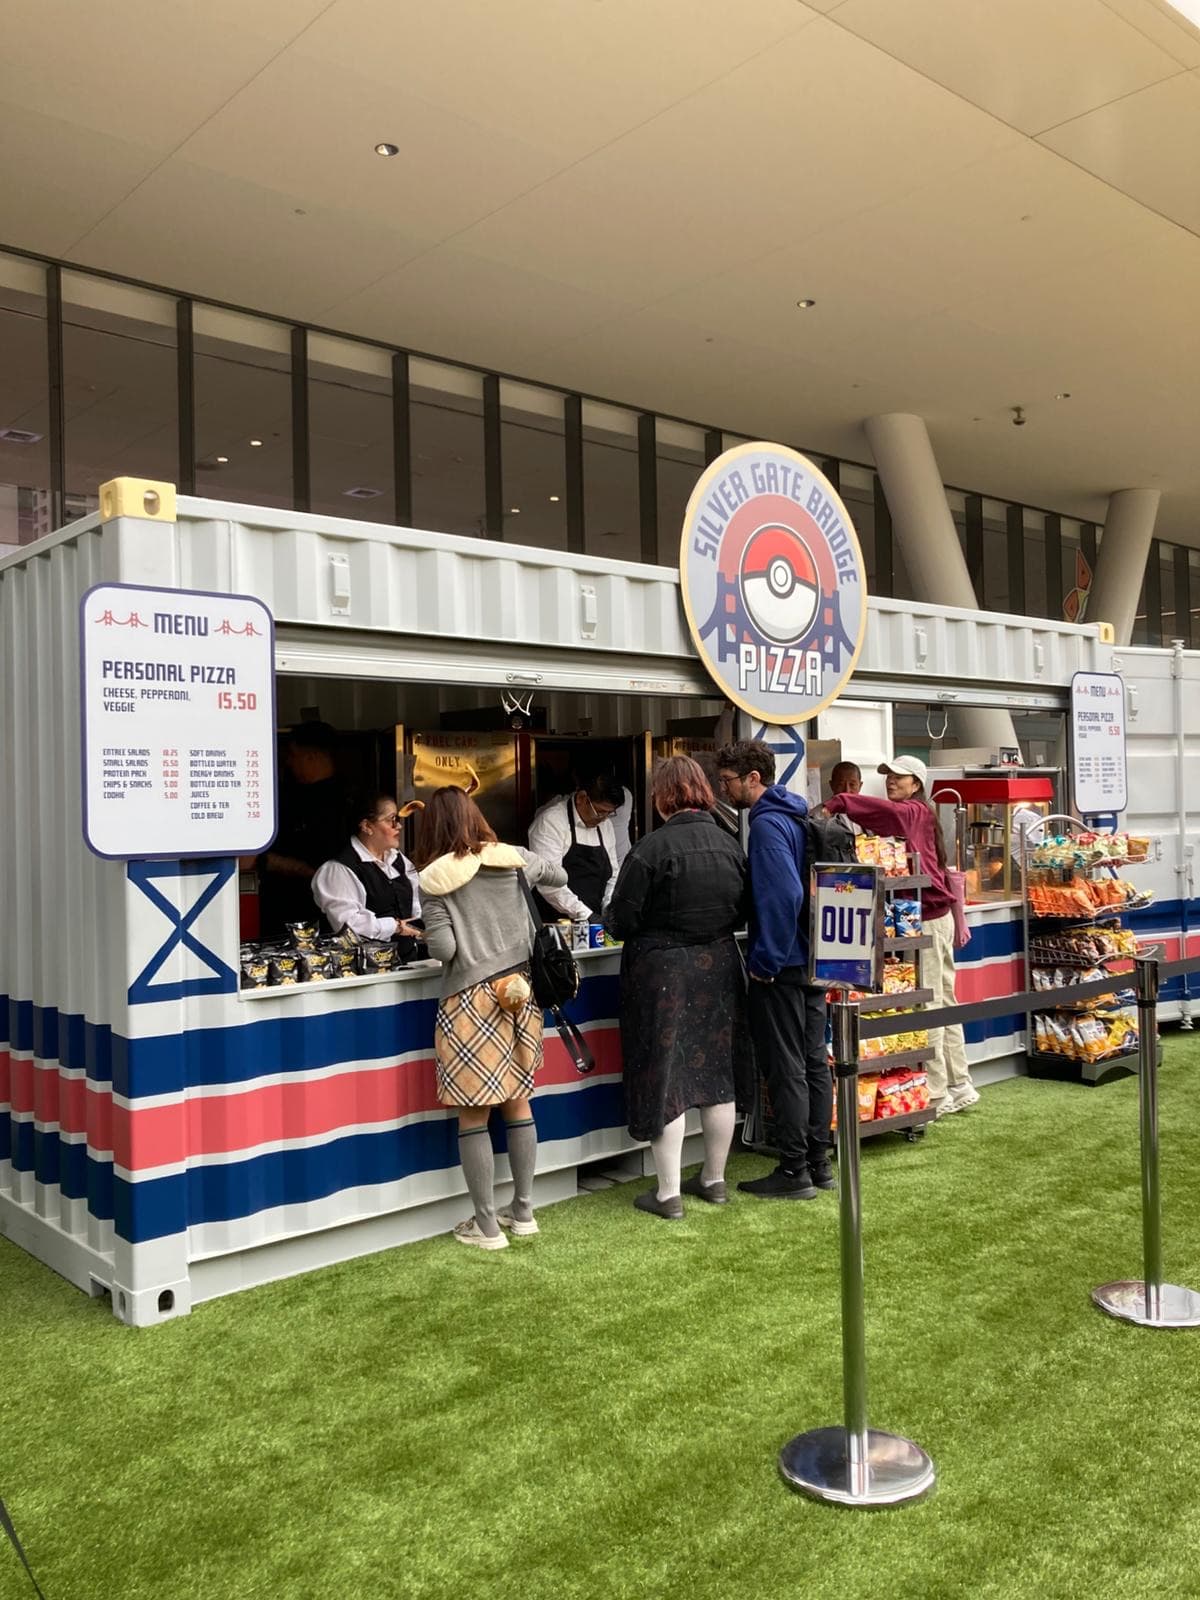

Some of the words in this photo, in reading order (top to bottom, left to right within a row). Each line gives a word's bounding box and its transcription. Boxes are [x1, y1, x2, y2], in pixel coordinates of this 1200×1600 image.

[694, 470, 749, 562] SILVER
[750, 462, 804, 502] GATE
[804, 485, 858, 585] BRIDGE
[154, 613, 208, 637] MENU
[103, 660, 186, 682] PERSONAL
[191, 666, 236, 685] PIZZA
[738, 642, 824, 697] PIZZA
[103, 687, 137, 699] CHEESE,
[218, 692, 257, 711] 15.50
[104, 702, 135, 713] VEGGIE
[128, 748, 151, 756] SALADS
[435, 756, 461, 768] ONLY
[821, 905, 872, 946] OUT
